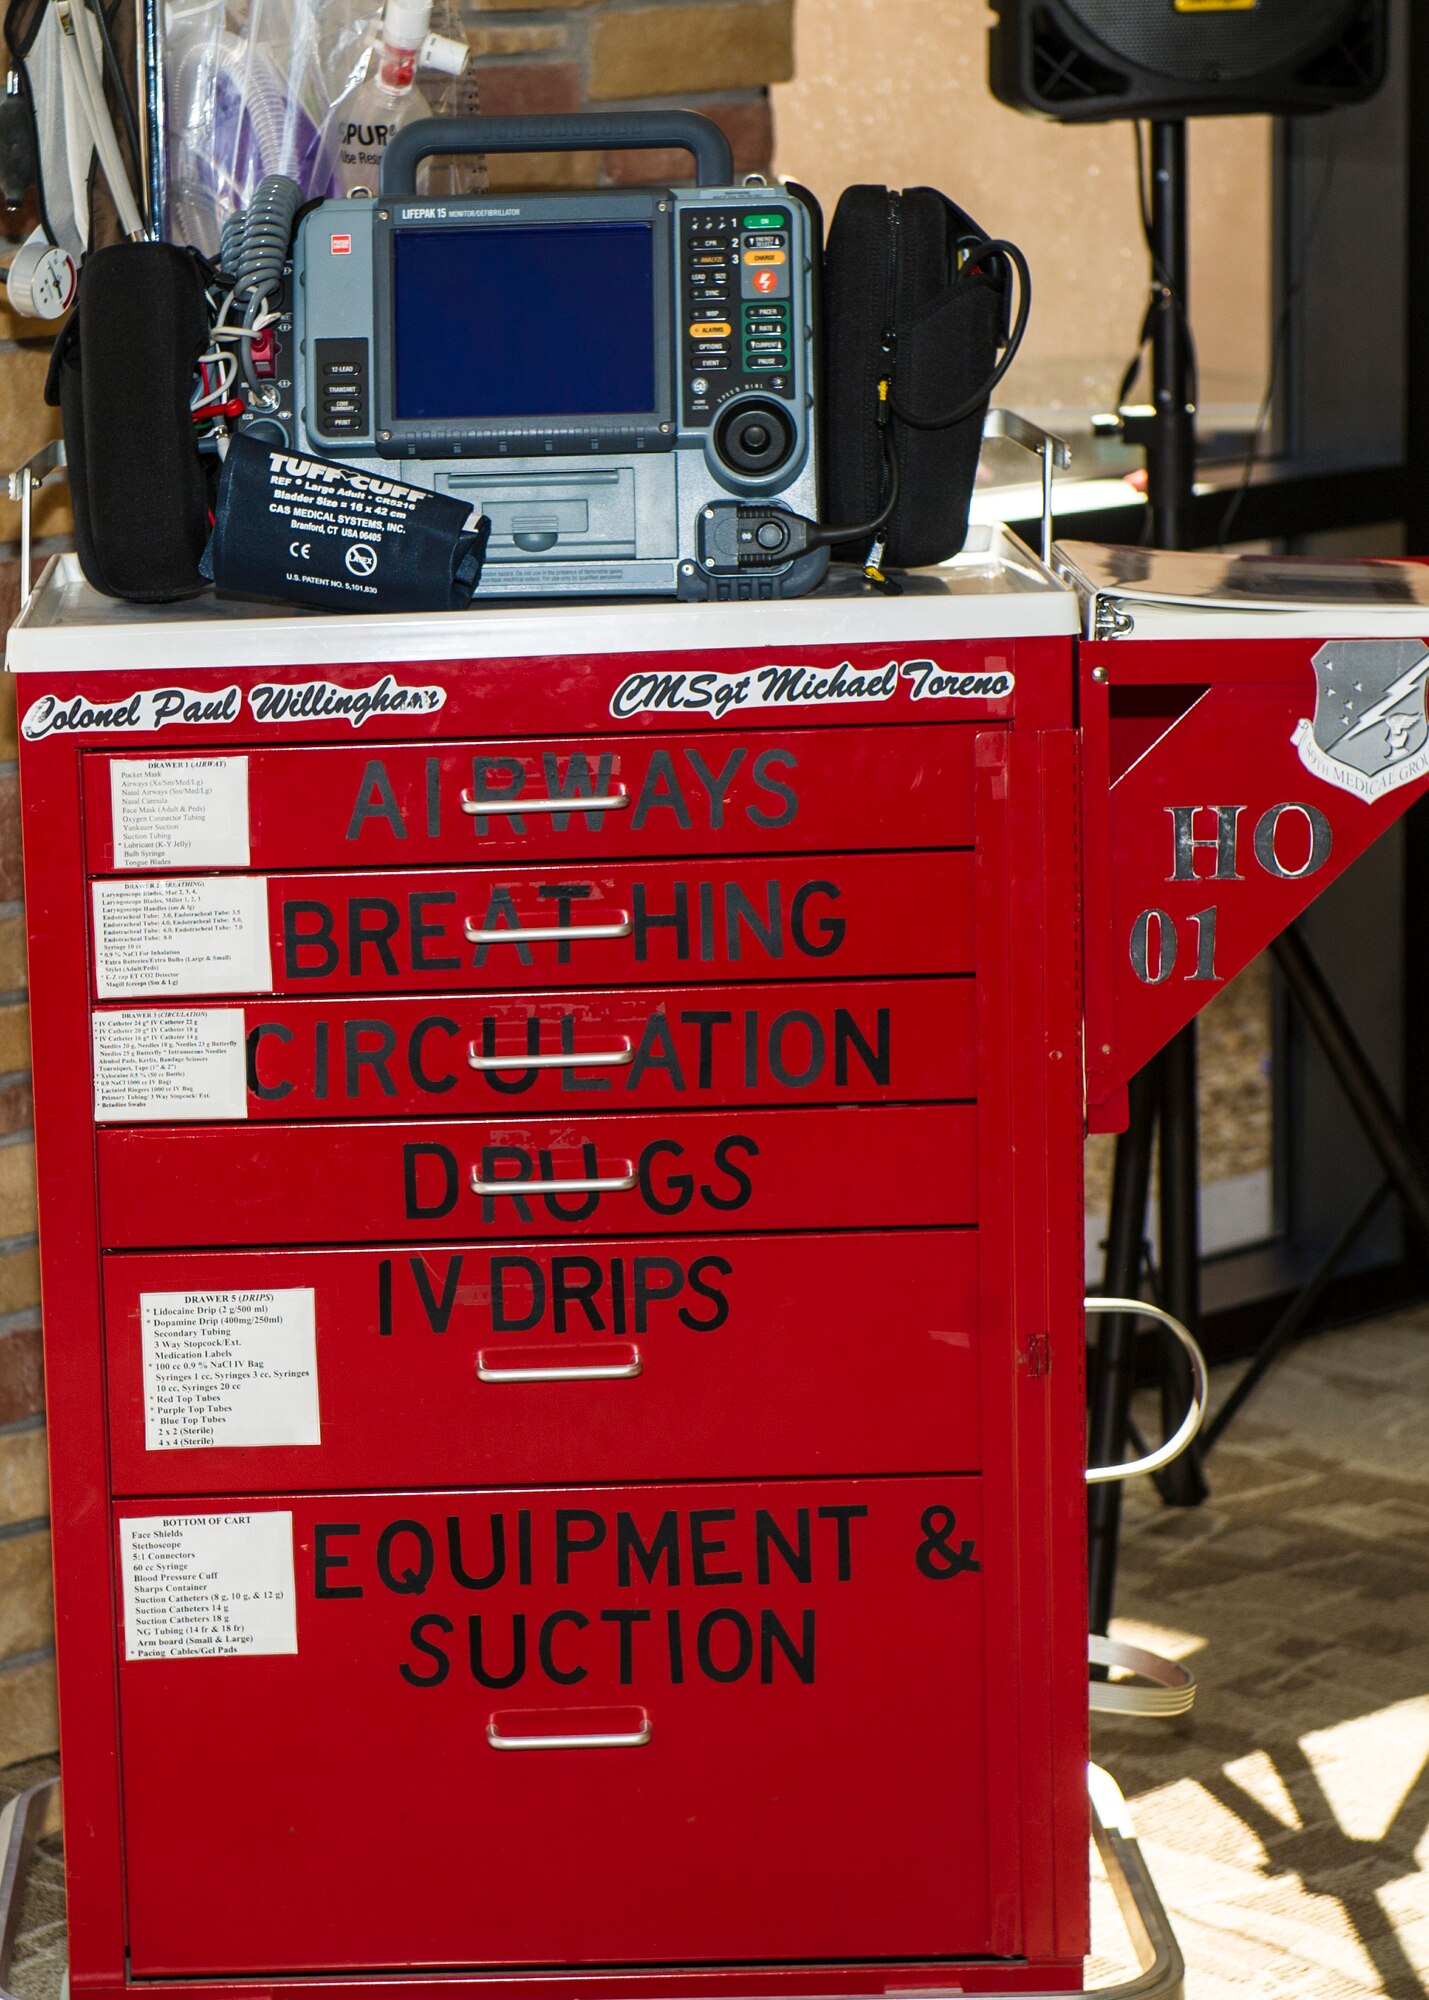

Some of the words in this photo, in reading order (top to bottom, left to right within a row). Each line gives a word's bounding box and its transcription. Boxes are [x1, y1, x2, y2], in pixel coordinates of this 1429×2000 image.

[402, 209, 436, 219] LIFEPAK
[437, 208, 446, 218] 15
[448, 209, 520, 218] MONITOR/DEFIBRILLATOR
[731, 218, 737, 228] 1
[732, 238, 739, 248] 2
[732, 254, 739, 264] 3
[270, 476, 292, 487] REF
[305, 481, 334, 495] Large
[336, 487, 365, 499] Adult
[374, 496, 416, 510] CR5216
[274, 489, 314, 504] Bladder
[316, 496, 338, 508] Size
[350, 502, 363, 512] 16
[374, 506, 388, 516] 42
[389, 511, 406, 519] cm
[269, 504, 291, 515] CAS
[293, 506, 335, 523] MEDICAL
[337, 515, 385, 532] SYSTEMS,
[387, 522, 406, 534] INC.
[290, 519, 325, 534] Branford,
[327, 526, 337, 535] CT
[342, 528, 358, 539] USA
[359, 530, 382, 542] 06405
[286, 573, 301, 582] U.S.
[302, 575, 329, 587] PATENT
[331, 580, 344, 589] NO.
[345, 582, 378, 594] 5,101,830
[612, 672, 749, 717] CMSgt
[757, 663, 896, 703] Michael
[901, 660, 1009, 699] Toreno
[25, 690, 141, 739] Colonel
[153, 687, 236, 728] Paul
[190, 760, 226, 768] (AIRWAY)
[1333, 767, 1396, 796] MEDICAL
[345, 748, 799, 841] AIRWAYS
[173, 840, 191, 848] Jelly)
[1162, 802, 1333, 882] HO
[140, 850, 165, 858] Syringe
[124, 859, 148, 867] Tongue
[282, 880, 847, 979] BREATHING
[1129, 905, 1224, 985] 01
[245, 1007, 891, 1100] CIRCULATION
[403, 1134, 760, 1224] DRUGS
[184, 1294, 229, 1303] DRAWER
[231, 1294, 236, 1302] 5
[238, 1293, 274, 1302] (DRIPS)
[378, 1254, 464, 1336] IV
[489, 1254, 734, 1335] DRIPS
[153, 1307, 194, 1315] Lidocaine
[196, 1306, 216, 1315] Drip
[218, 1305, 227, 1313] (2
[228, 1305, 251, 1314] g/500
[253, 1304, 268, 1313] ml)
[153, 1318, 196, 1328] Dopamine
[198, 1317, 218, 1326] Drip
[220, 1315, 283, 1325] (400mg/250ml)
[153, 1329, 197, 1339] Secondary
[200, 1327, 231, 1336] Tubing
[161, 1340, 180, 1349] Way
[183, 1338, 241, 1349] Stopcock/Ext.
[154, 1350, 201, 1359] Medication
[204, 1349, 232, 1357] Labels
[156, 1395, 173, 1403] Red
[177, 1394, 192, 1404] Top
[162, 1518, 206, 1526] BOTTOM
[223, 1516, 252, 1524] CART
[152, 1529, 183, 1537] Shields
[131, 1540, 181, 1551] Stethoscope
[132, 1552, 145, 1560] 5:1
[147, 1551, 196, 1559] Connectors
[313, 1504, 869, 1600] EQUIPMENT
[915, 1504, 982, 1582] &
[155, 1562, 188, 1572] Syringe
[133, 1574, 158, 1582] Blood
[160, 1572, 196, 1581] Pressure
[133, 1584, 163, 1595] Sharps
[165, 1583, 207, 1591] Container
[158, 1637, 183, 1645] board
[185, 1636, 213, 1644] (Small
[214, 1635, 223, 1643] &
[225, 1634, 253, 1644] Large)
[137, 1649, 166, 1658] Pacing
[169, 1646, 215, 1655] Cables/Gel
[217, 1645, 237, 1653] Pads
[399, 1608, 816, 1690] SUCTION
